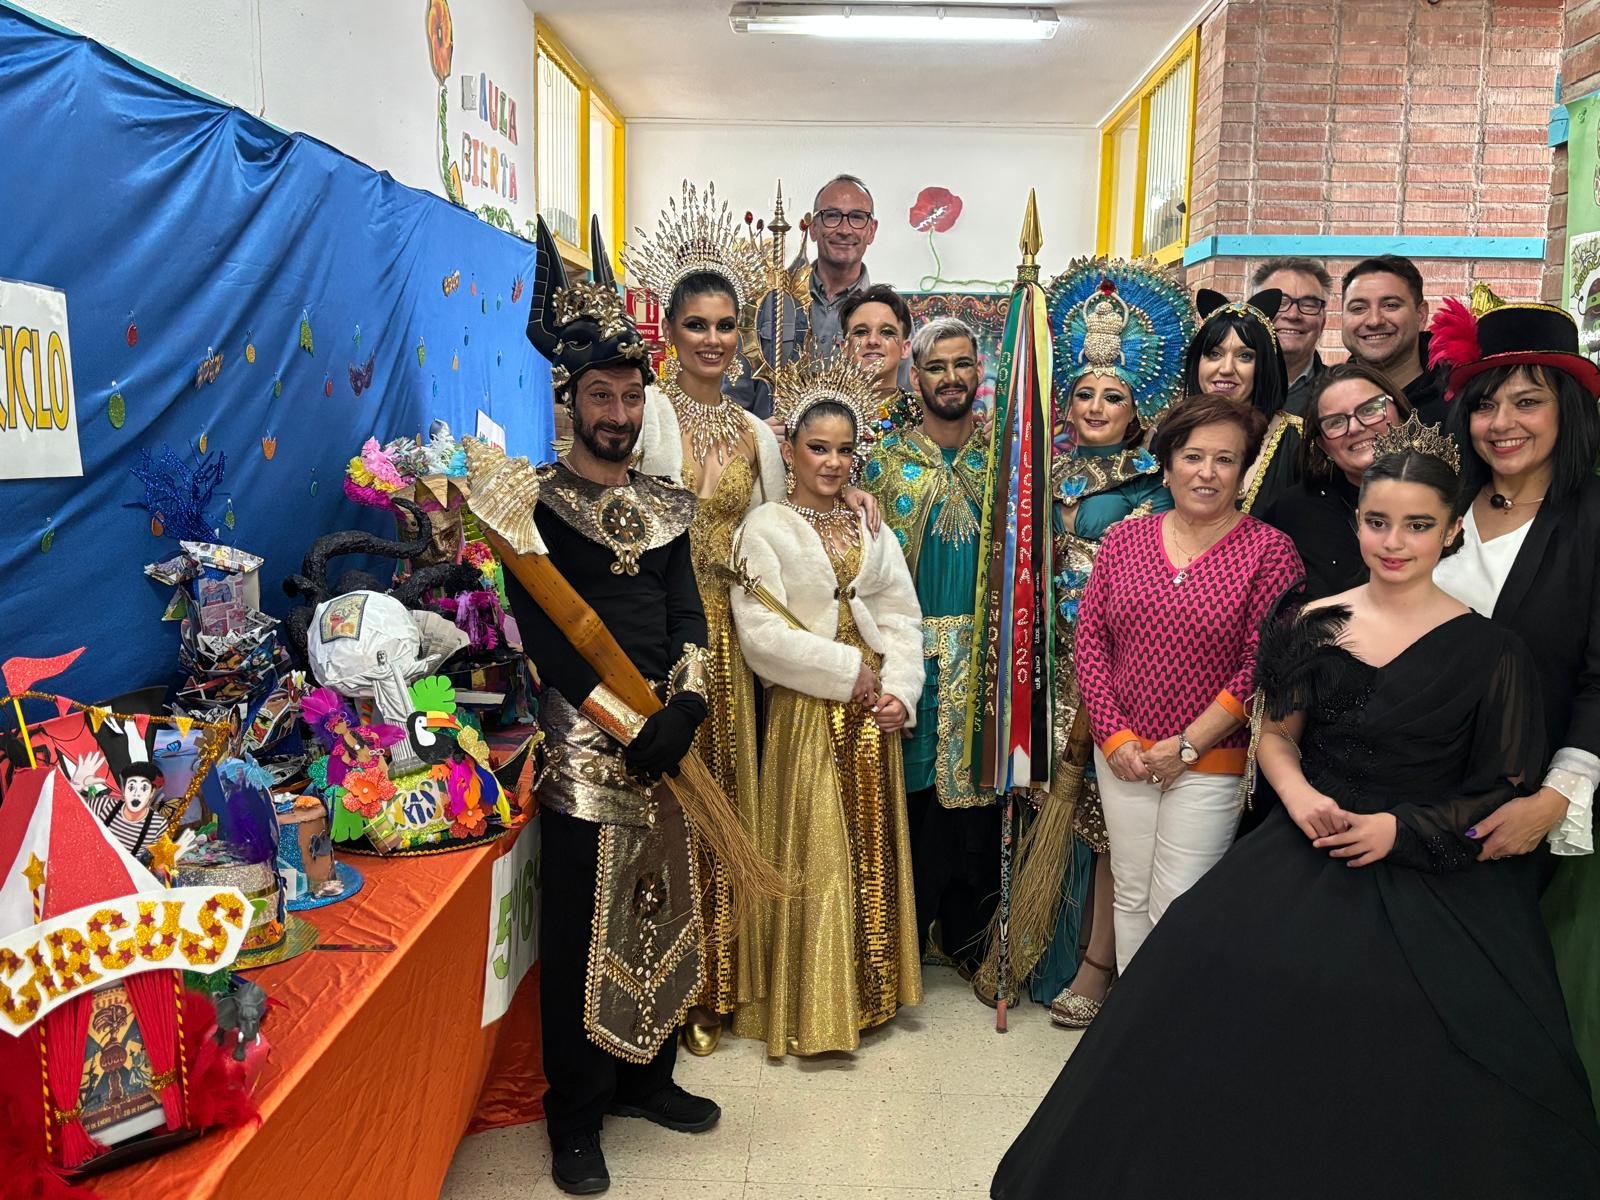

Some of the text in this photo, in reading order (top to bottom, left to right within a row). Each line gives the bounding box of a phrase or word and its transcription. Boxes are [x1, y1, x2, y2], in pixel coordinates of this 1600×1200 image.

[479, 72, 518, 146] AULA
[462, 131, 517, 204] BIERTA
[0, 892, 246, 1026] CIRCUS
